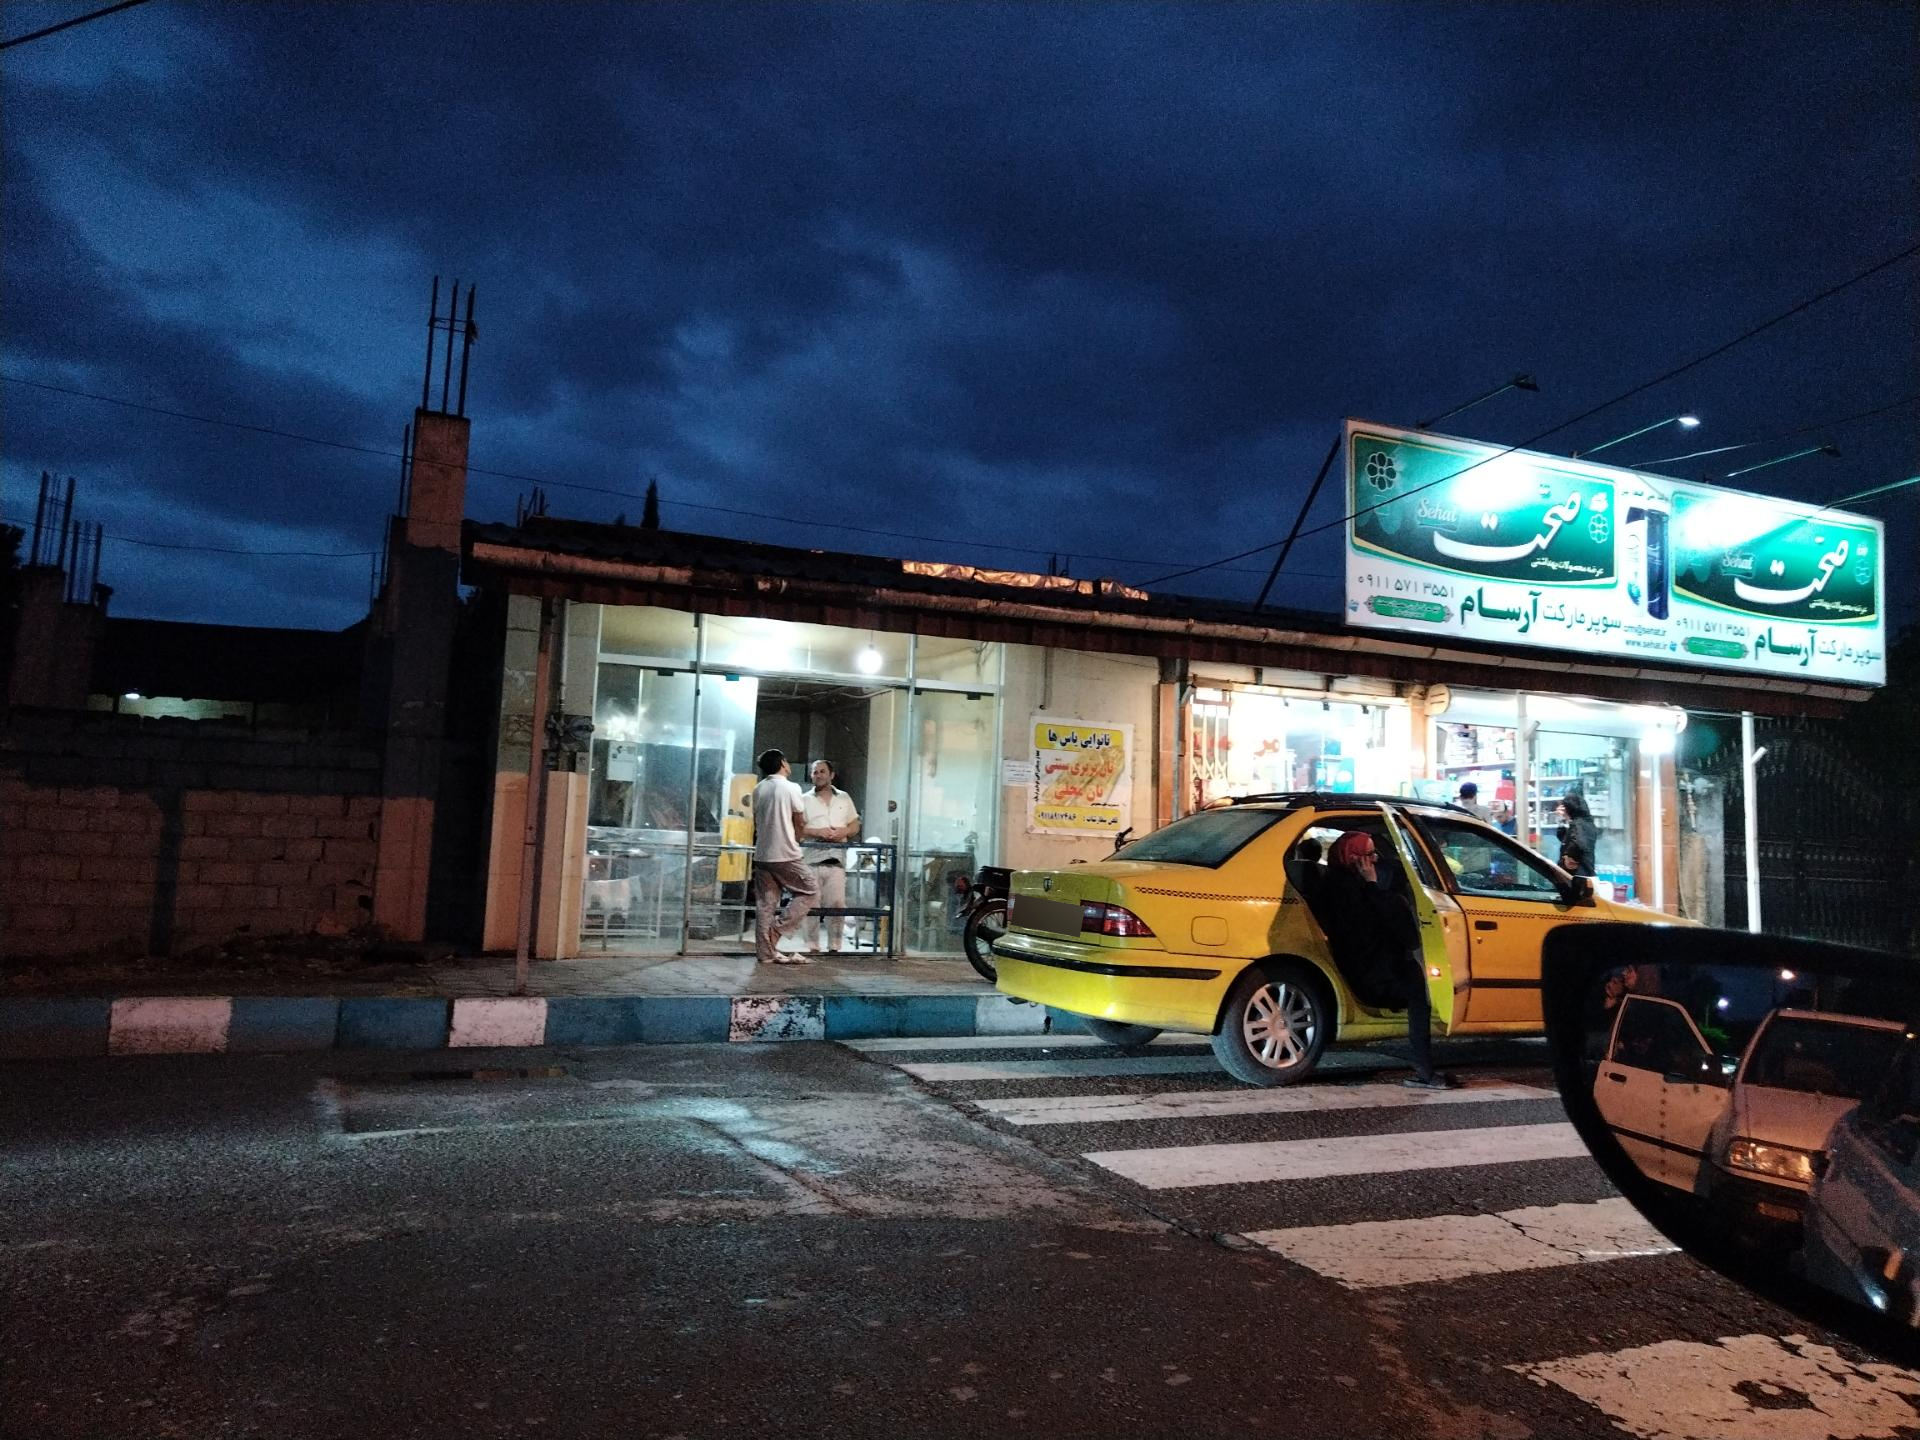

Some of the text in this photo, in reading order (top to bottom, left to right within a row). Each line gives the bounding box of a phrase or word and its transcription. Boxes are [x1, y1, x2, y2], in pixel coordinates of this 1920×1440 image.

[1460, 586, 1541, 633] آرسام
[1754, 627, 1816, 666] آرسام
[1080, 733, 1110, 749] نانوایی
[1087, 784, 1103, 802] نان
